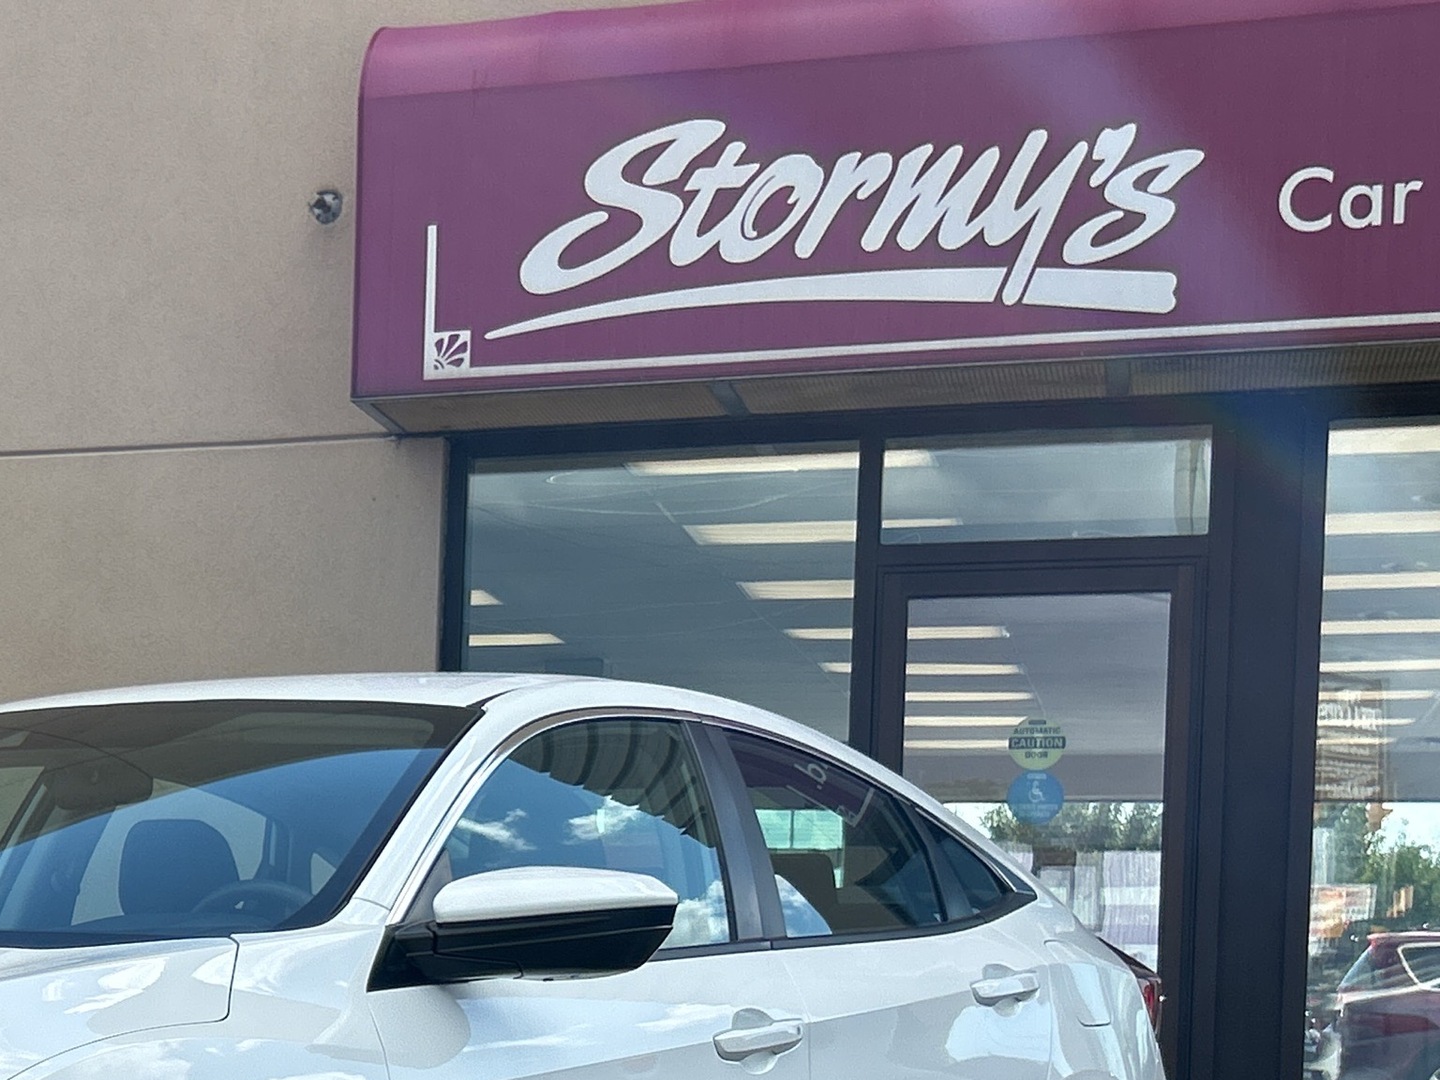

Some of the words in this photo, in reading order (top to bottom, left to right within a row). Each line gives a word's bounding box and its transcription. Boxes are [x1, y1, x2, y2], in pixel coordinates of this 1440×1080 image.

[519, 119, 1205, 305] Stormy's
[1278, 166, 1424, 232] Car
[1011, 738, 1063, 748] CAUTION
